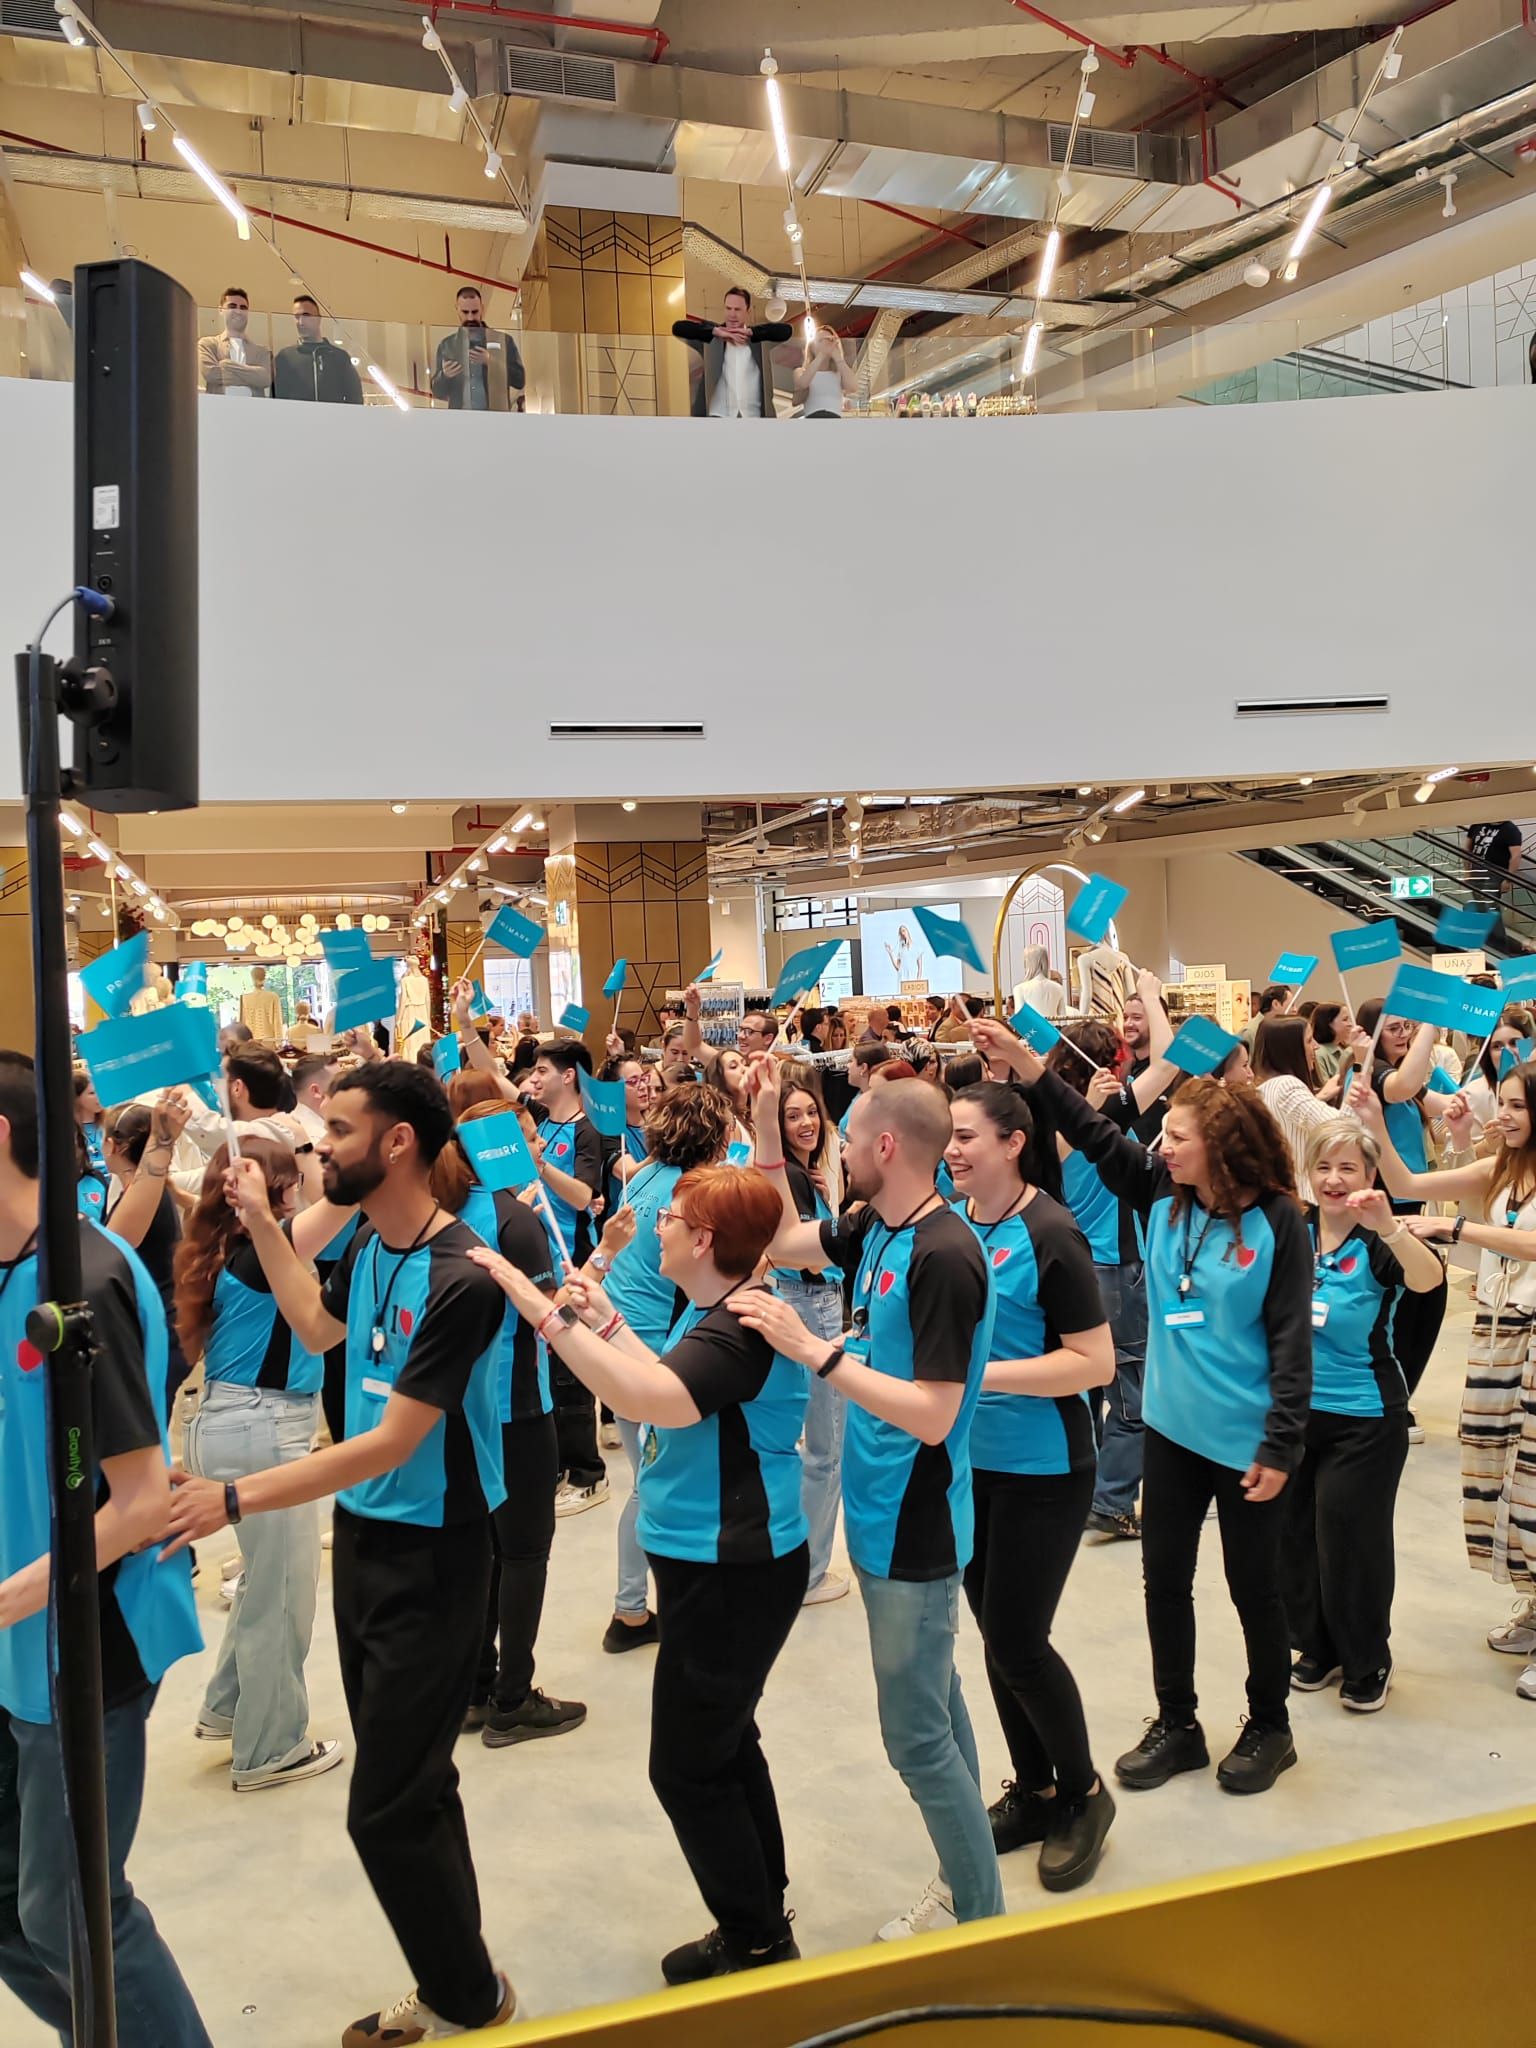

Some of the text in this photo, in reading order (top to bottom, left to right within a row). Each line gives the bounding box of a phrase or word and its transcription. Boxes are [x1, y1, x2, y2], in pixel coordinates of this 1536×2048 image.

[1444, 958, 1473, 968] UÑAS
[1193, 970, 1215, 979] OJOS
[1461, 1003, 1498, 1018] RIMAR
[68, 1427, 81, 1471] Gravity
